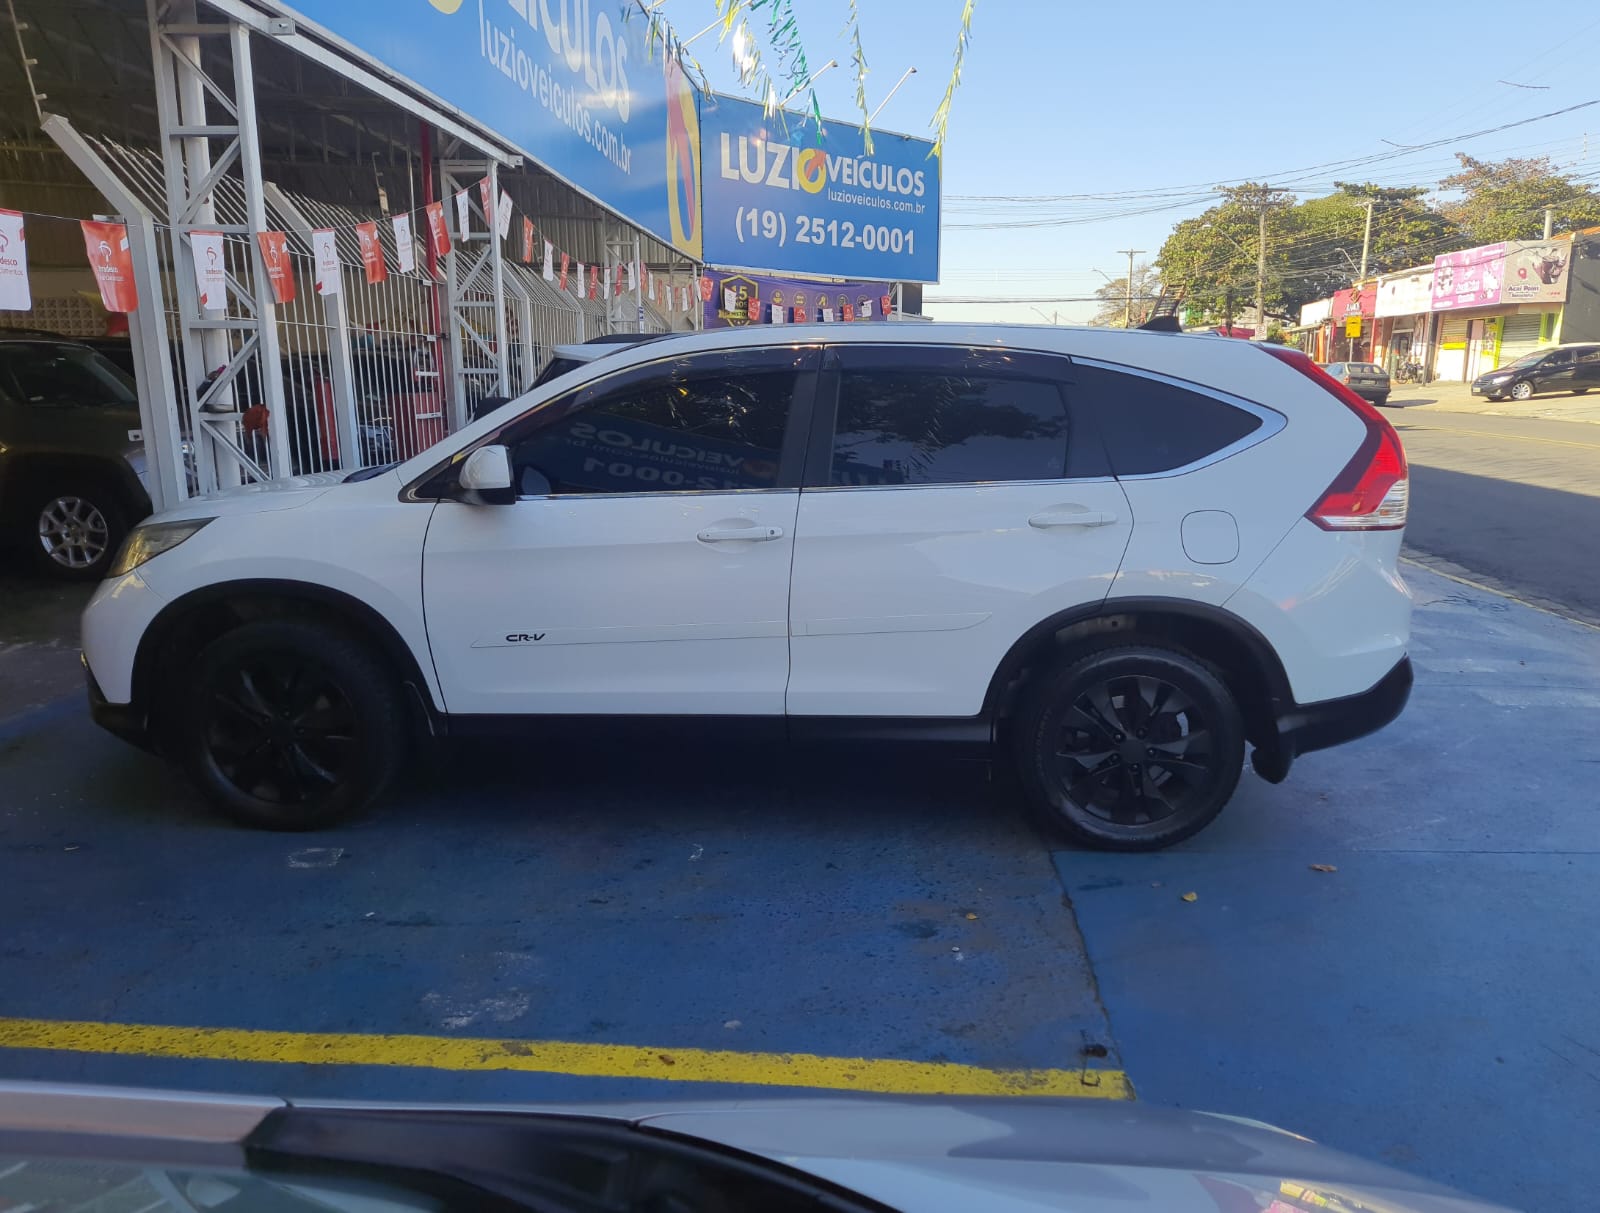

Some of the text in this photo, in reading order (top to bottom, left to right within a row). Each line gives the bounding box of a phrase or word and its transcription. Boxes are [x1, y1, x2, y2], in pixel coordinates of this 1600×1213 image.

[478, 0, 632, 175] luzioveiculos.com.br
[827, 187, 926, 215] luzioveiculos.com.br
[735, 206, 915, 256] (19) 2512-0001
[505, 633, 546, 642] CR-V
